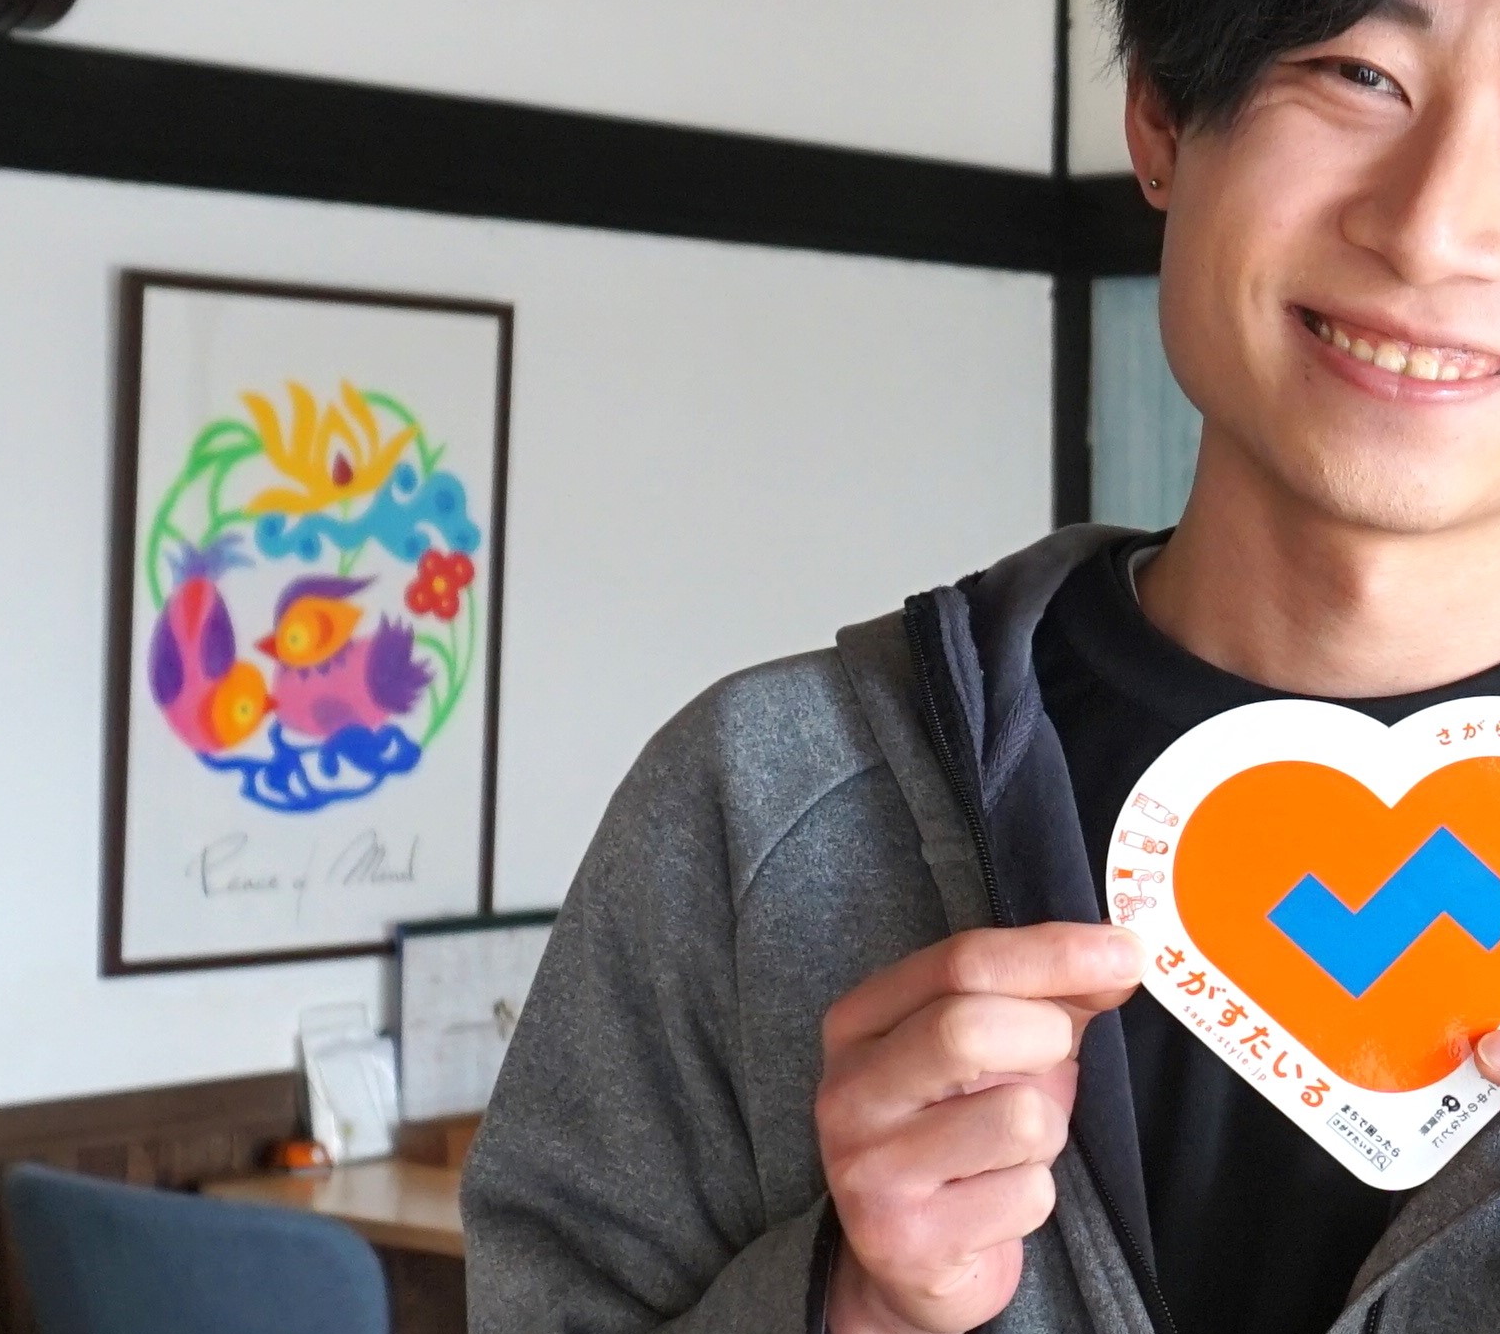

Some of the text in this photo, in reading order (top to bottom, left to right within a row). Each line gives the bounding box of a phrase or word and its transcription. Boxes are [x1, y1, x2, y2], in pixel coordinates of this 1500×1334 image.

[1155, 945, 1332, 1108] さがすたいる
[1183, 1004, 1268, 1082] saga-style.jp
[1332, 1118, 1374, 1156] さがすたいる
[1340, 1103, 1401, 1158] まちで困ったら
